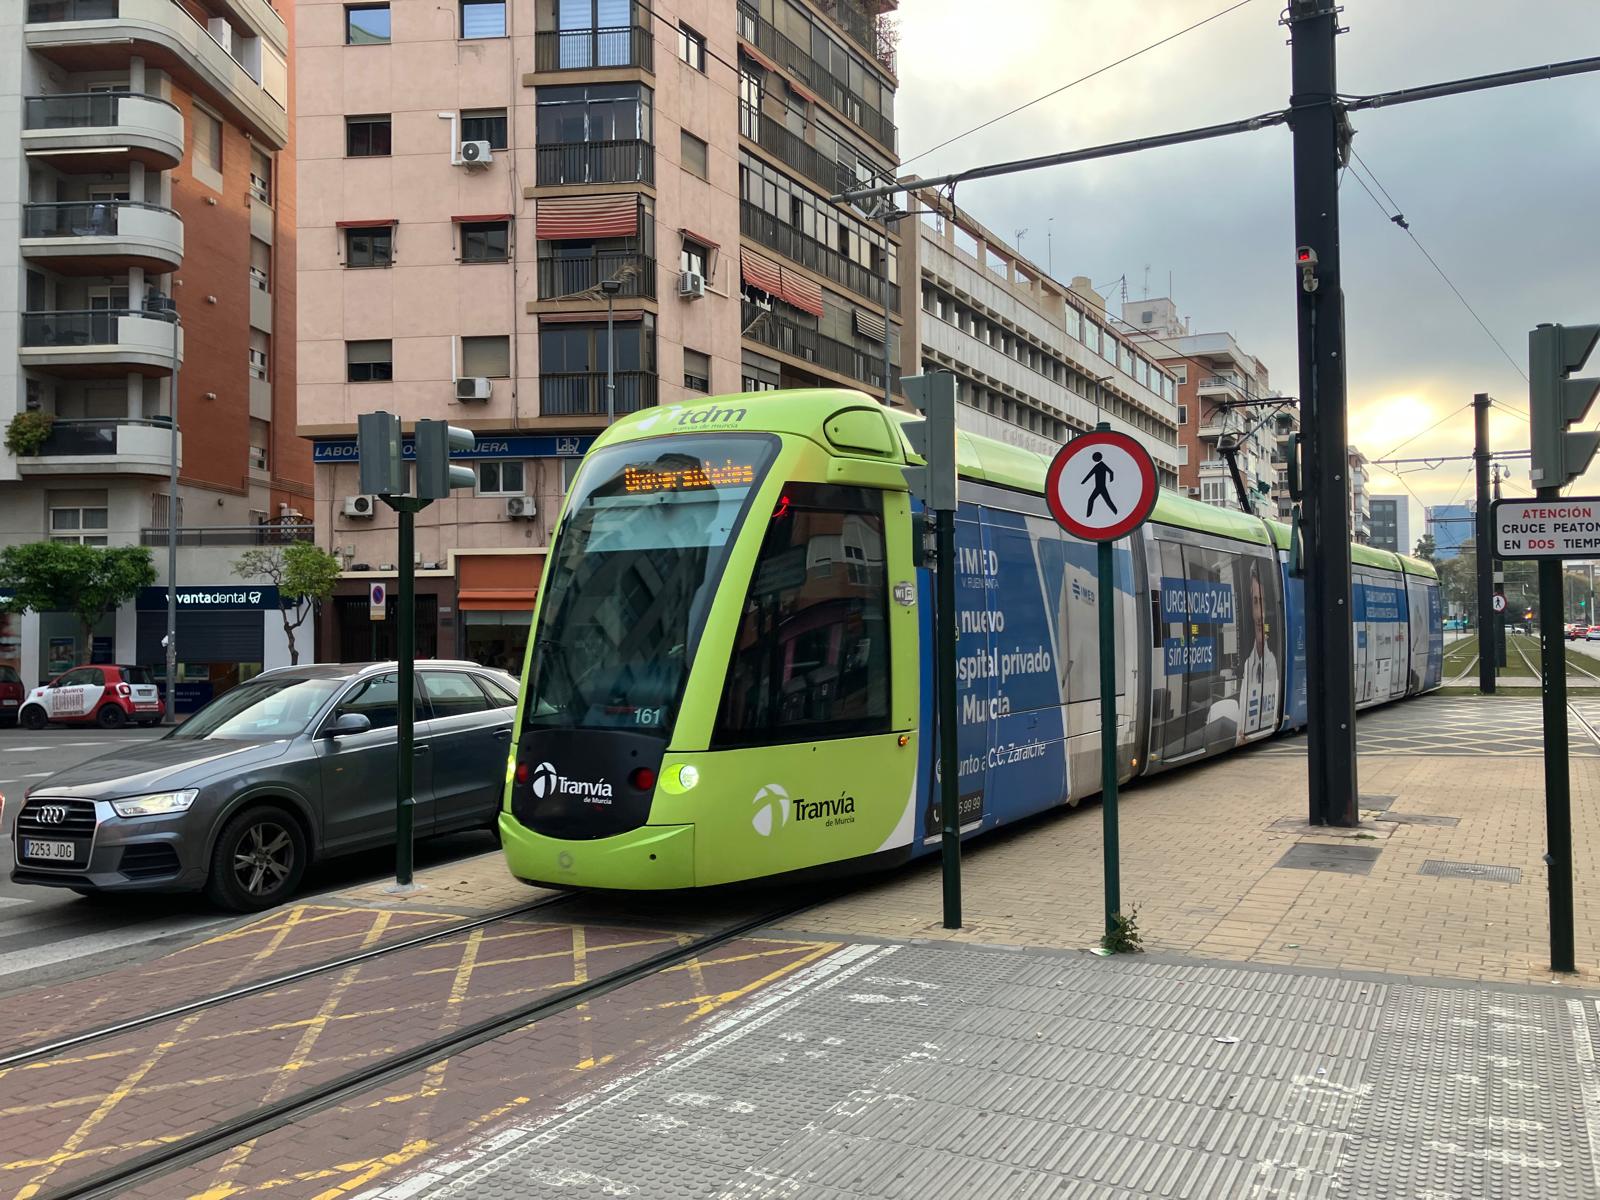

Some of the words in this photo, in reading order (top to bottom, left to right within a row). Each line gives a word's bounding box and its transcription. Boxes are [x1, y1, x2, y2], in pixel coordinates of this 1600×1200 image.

[678, 405, 747, 426] tdm
[1522, 506, 1592, 519] ATENCIÓN
[1502, 523, 1546, 534] CRUCE
[1504, 540, 1521, 550] EN
[1528, 539, 1556, 549] DOS
[959, 547, 998, 576] IMED
[1165, 590, 1210, 614] URGENCIAS
[1211, 590, 1231, 619] 24H
[961, 611, 1004, 633] nuevo
[1168, 641, 1181, 667] sin
[1002, 645, 1051, 684] privado
[634, 708, 661, 725] 161
[963, 690, 1010, 725] Murcia
[558, 778, 613, 797] Tranvía
[592, 797, 612, 805] Murcia
[793, 791, 855, 821] Tranvía
[825, 819, 833, 827] de
[835, 815, 855, 826] Murcia
[30, 842, 51, 857] 2253
[54, 844, 72, 858] JDG
